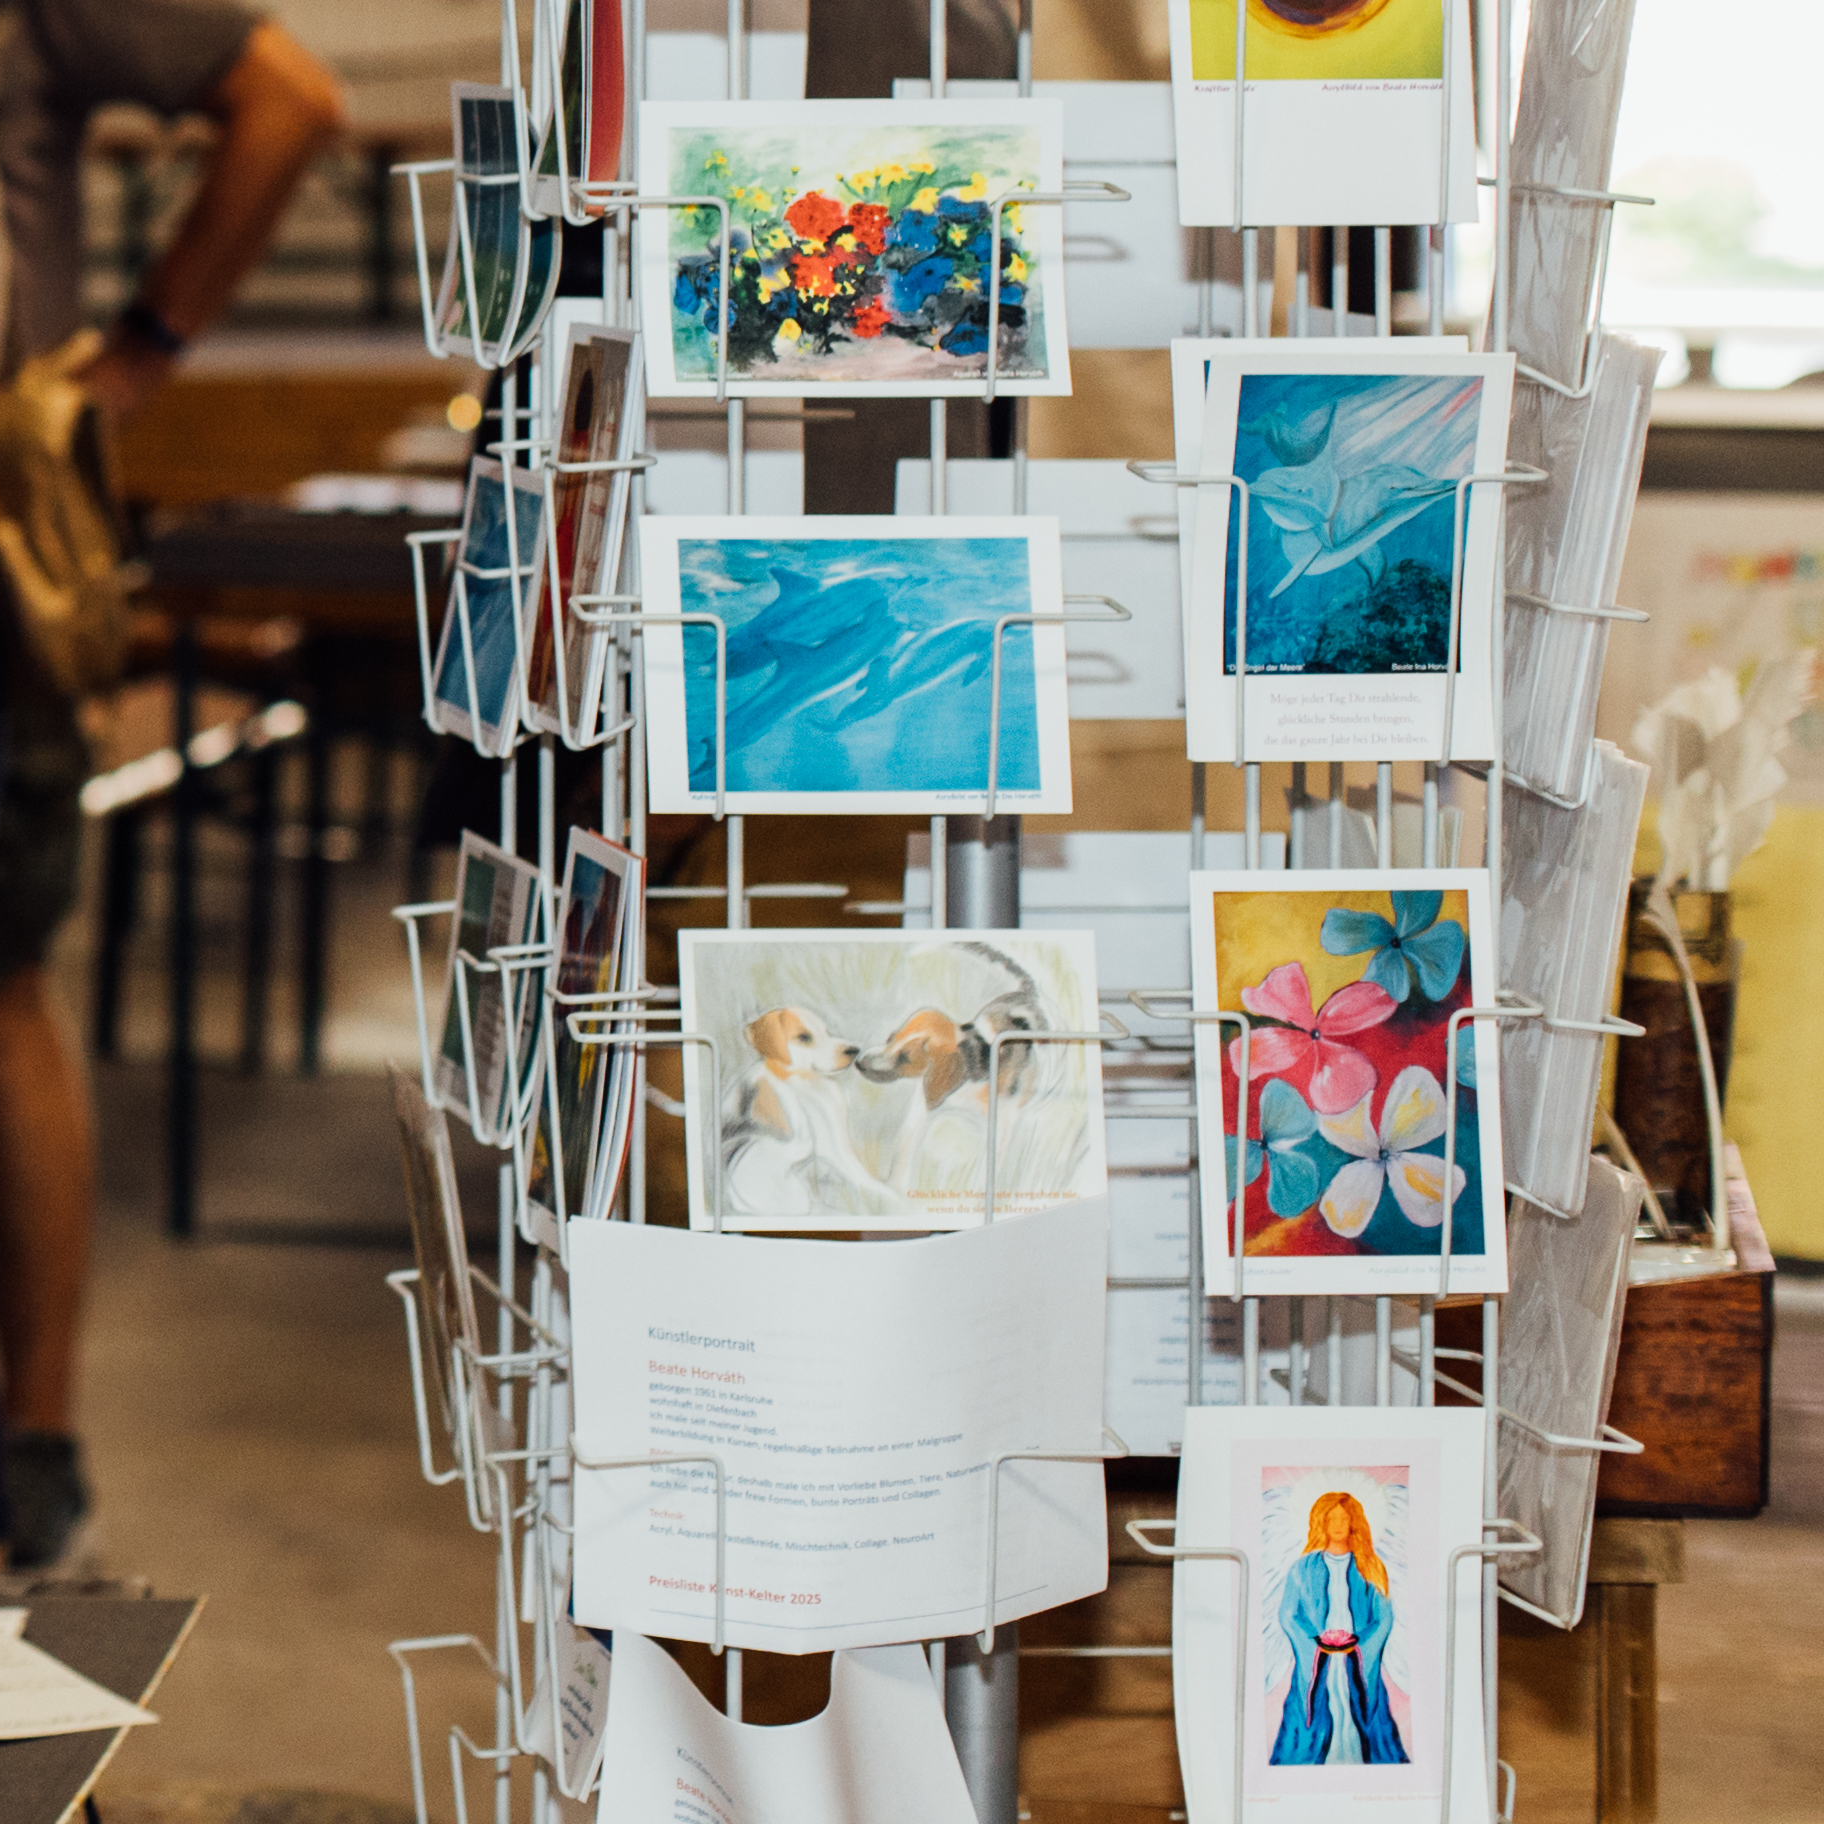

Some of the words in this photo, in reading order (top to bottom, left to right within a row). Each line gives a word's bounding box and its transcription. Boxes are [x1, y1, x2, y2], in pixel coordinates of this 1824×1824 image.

[1270, 693, 1298, 706] Möge
[1300, 693, 1325, 705] jeder
[1327, 693, 1346, 706] Tag
[1349, 692, 1366, 703] Dir
[1330, 713, 1370, 724] Stunden
[1264, 734, 1279, 745] die
[1281, 734, 1297, 745] das
[1300, 736, 1328, 747] ganze
[1330, 734, 1349, 747] Jahr
[1353, 734, 1368, 744] bei
[1371, 734, 1387, 744] Dir
[957, 1204, 969, 1214] du
[648, 1326, 756, 1353] Künstlerportrait
[648, 1360, 687, 1377] Beate
[691, 1366, 745, 1385] Horváth
[694, 1387, 717, 1399] 1961
[719, 1390, 728, 1400] in
[730, 1392, 774, 1406] Karlsruhe
[649, 1396, 692, 1410] wohnhaft
[695, 1401, 703, 1411] in
[706, 1403, 757, 1418] Diefenbach
[665, 1412, 688, 1425] male
[690, 1416, 706, 1426] seit
[709, 1420, 741, 1431] meiner
[650, 1426, 714, 1444] Weiterbildung
[716, 1434, 725, 1444] in
[763, 1443, 822, 1456] regelmäßige
[826, 1445, 875, 1455] Teilnahme
[891, 1440, 914, 1451] einer
[917, 1433, 964, 1448] Malgruppe
[690, 1469, 705, 1479] die
[737, 1475, 773, 1488] deshalb
[775, 1481, 799, 1491] male
[801, 1482, 815, 1491] ich
[818, 1483, 835, 1491] mit
[837, 1480, 877, 1491] Vorliebe
[650, 1480, 672, 1490] auch
[691, 1485, 709, 1494] und
[712, 1489, 743, 1499] weder
[745, 1490, 766, 1502] freie
[811, 1497, 840, 1507] bunte
[842, 1494, 879, 1506] Porträts
[882, 1493, 899, 1502] und
[893, 1532, 935, 1545] NeuroArt
[649, 1575, 705, 1593] Preisliste
[709, 1583, 786, 1604] Knst-Kelter
[790, 1593, 822, 1605] 2025
